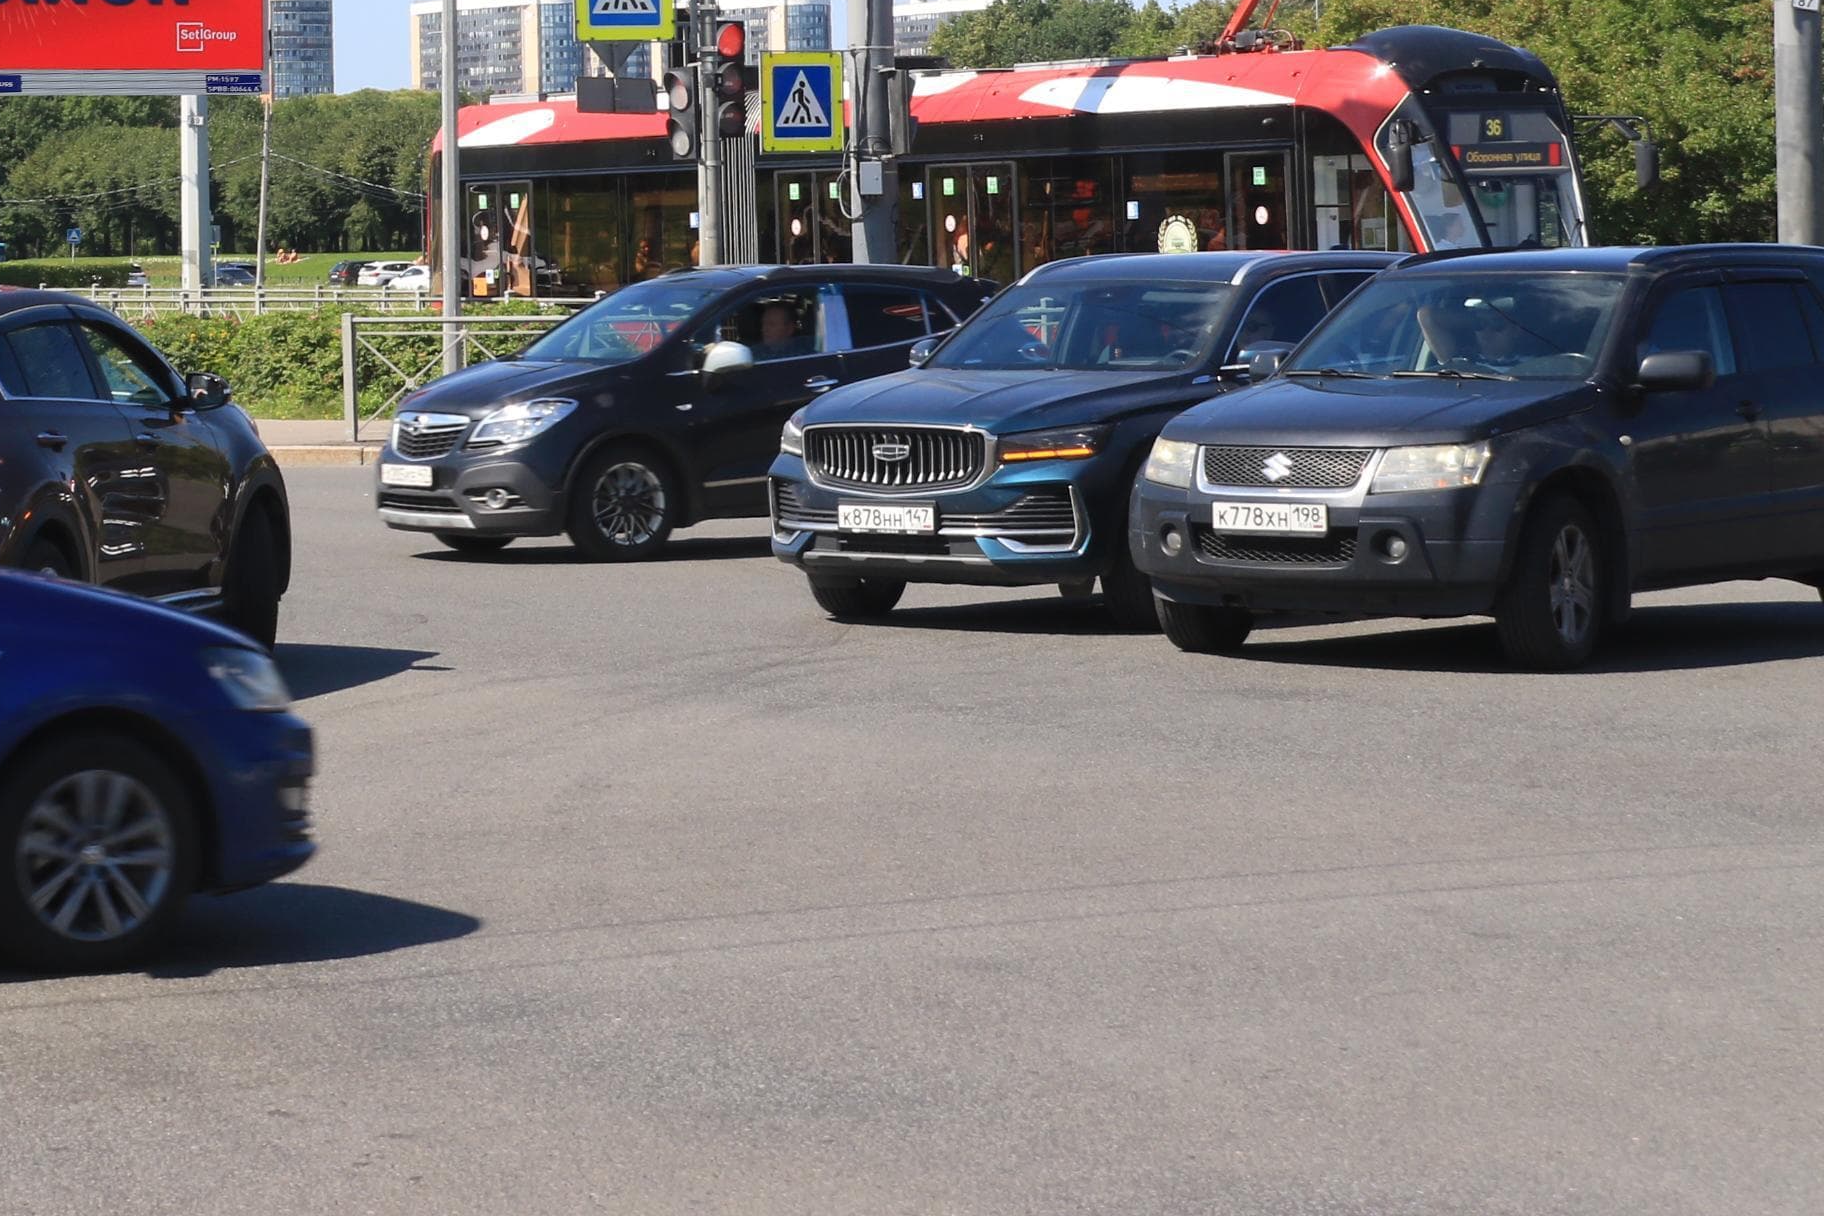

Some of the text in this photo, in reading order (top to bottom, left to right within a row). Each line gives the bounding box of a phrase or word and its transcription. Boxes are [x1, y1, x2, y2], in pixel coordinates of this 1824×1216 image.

[1485, 119, 1502, 136] 36
[1466, 151, 1542, 163] Оборонная улица
[905, 508, 929, 524] 147
[1292, 506, 1321, 522] 198
